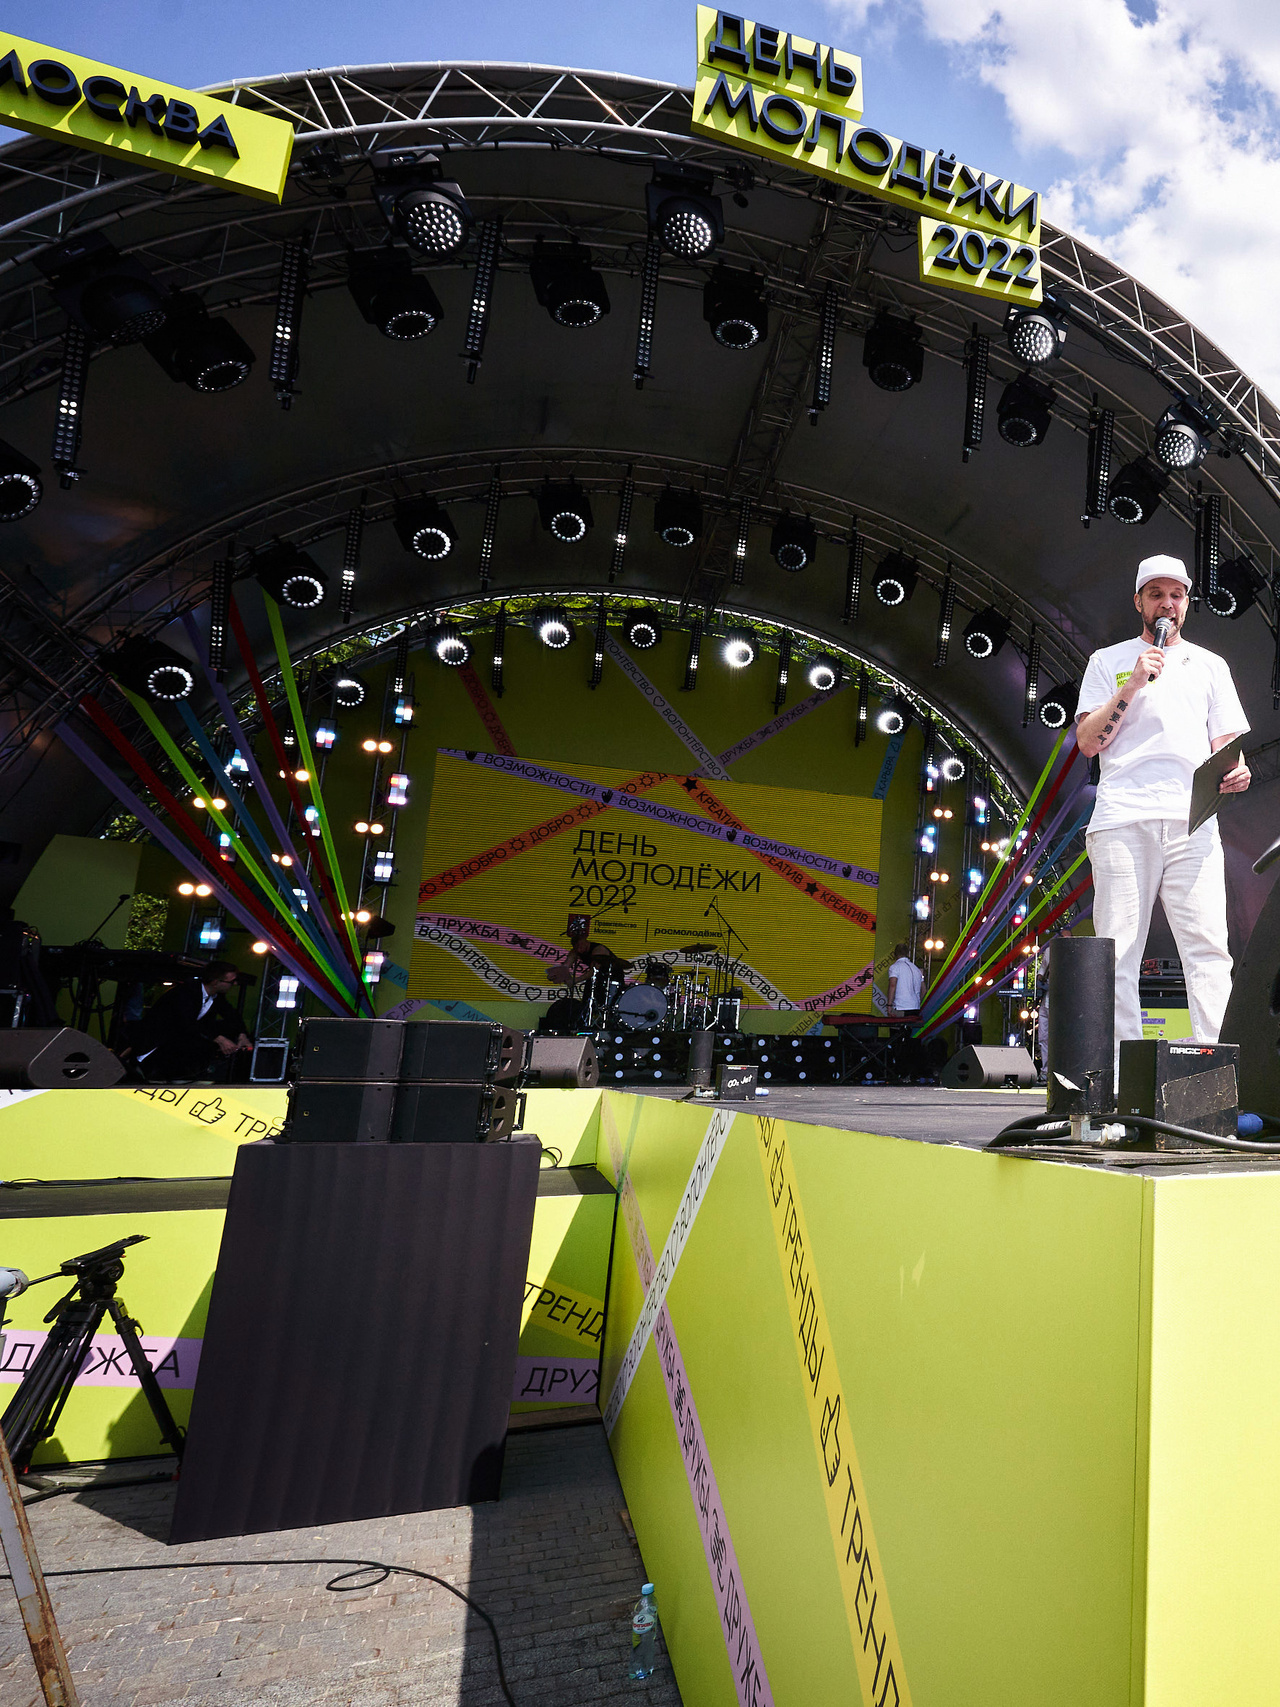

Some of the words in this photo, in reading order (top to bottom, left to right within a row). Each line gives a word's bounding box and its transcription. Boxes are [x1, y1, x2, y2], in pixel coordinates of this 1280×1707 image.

[708, 10, 856, 97] ДЕНЬ
[703, 71, 1039, 234] МОЛОДЁЖИ
[932, 224, 1039, 289] 2022
[601, 632, 655, 697] ОЛОНТЁРСТВО
[662, 707, 722, 776] ВОЛОНТЁРСТВО
[720, 737, 757, 764] ДРУЖБА
[774, 703, 808, 731] ДРУЖБА
[877, 754, 896, 793] КАРЬЕРА
[483, 753, 596, 796] ВОЗМОЖНОСТИ
[618, 795, 722, 836] ВОЗМОЖНОСТИ
[742, 834, 838, 872] ВОЗМОЖНОСТИ
[573, 829, 657, 857] ДЕНЬ
[459, 847, 507, 880] ДОБРО
[529, 813, 574, 845] ДОБРО
[570, 857, 761, 893] МОЛОДЁЖИ
[569, 885, 637, 907] 2022
[819, 891, 869, 925] КРЕАТИВ
[418, 925, 521, 995] ВОЛОНТЁРСТВО
[804, 985, 855, 1012] ДРУЖБА
[782, 1183, 825, 1398] ТРЕНДЫ
[723, 1568, 766, 1707] ДРУЖ
